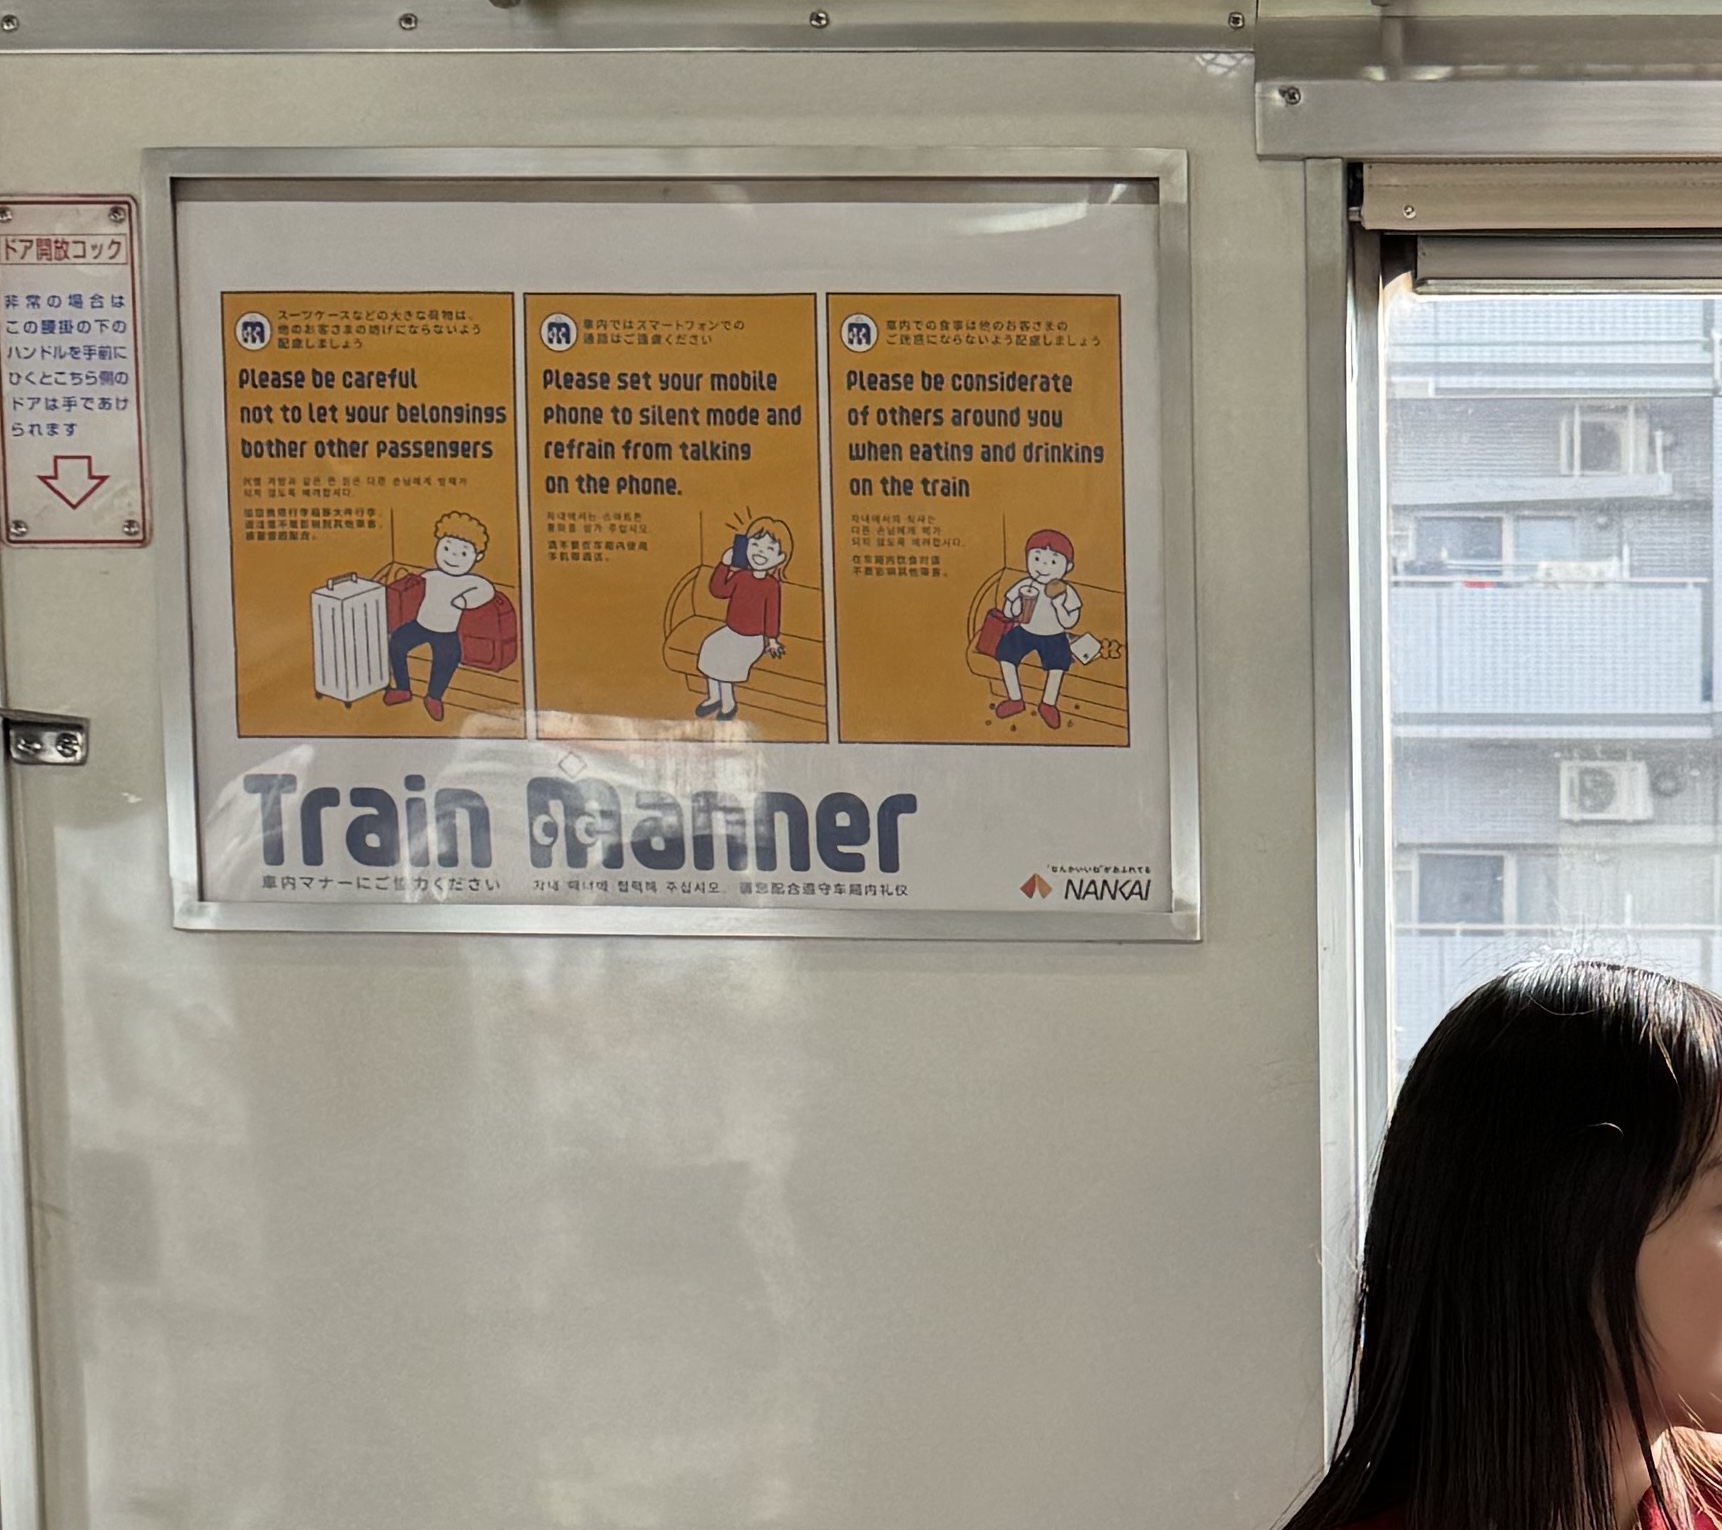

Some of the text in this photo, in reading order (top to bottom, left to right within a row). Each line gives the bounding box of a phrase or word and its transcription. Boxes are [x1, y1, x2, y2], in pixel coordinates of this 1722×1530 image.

[3, 238, 124, 262] ドア開放コック
[4, 294, 126, 310] 非常の場合は
[7, 345, 129, 361] ハンドルを手前に
[239, 367, 418, 389] Please be careful
[543, 369, 778, 392] Please set your mobile
[846, 369, 1074, 393] Please be considerate
[11, 396, 130, 412] ドアは手であけ
[240, 402, 508, 425] not to let your belongings
[543, 404, 803, 426] phone to silent mode and
[847, 405, 1064, 428] of others around you
[12, 422, 78, 438] られます
[241, 438, 494, 459] bother other passengers
[544, 438, 752, 461] refrain from talking
[848, 440, 1105, 464] when eating and drinking
[545, 473, 684, 496] on the phone.
[849, 475, 971, 498] on the train
[243, 773, 918, 874] Train Manner
[1063, 878, 1152, 901] NANKAI
